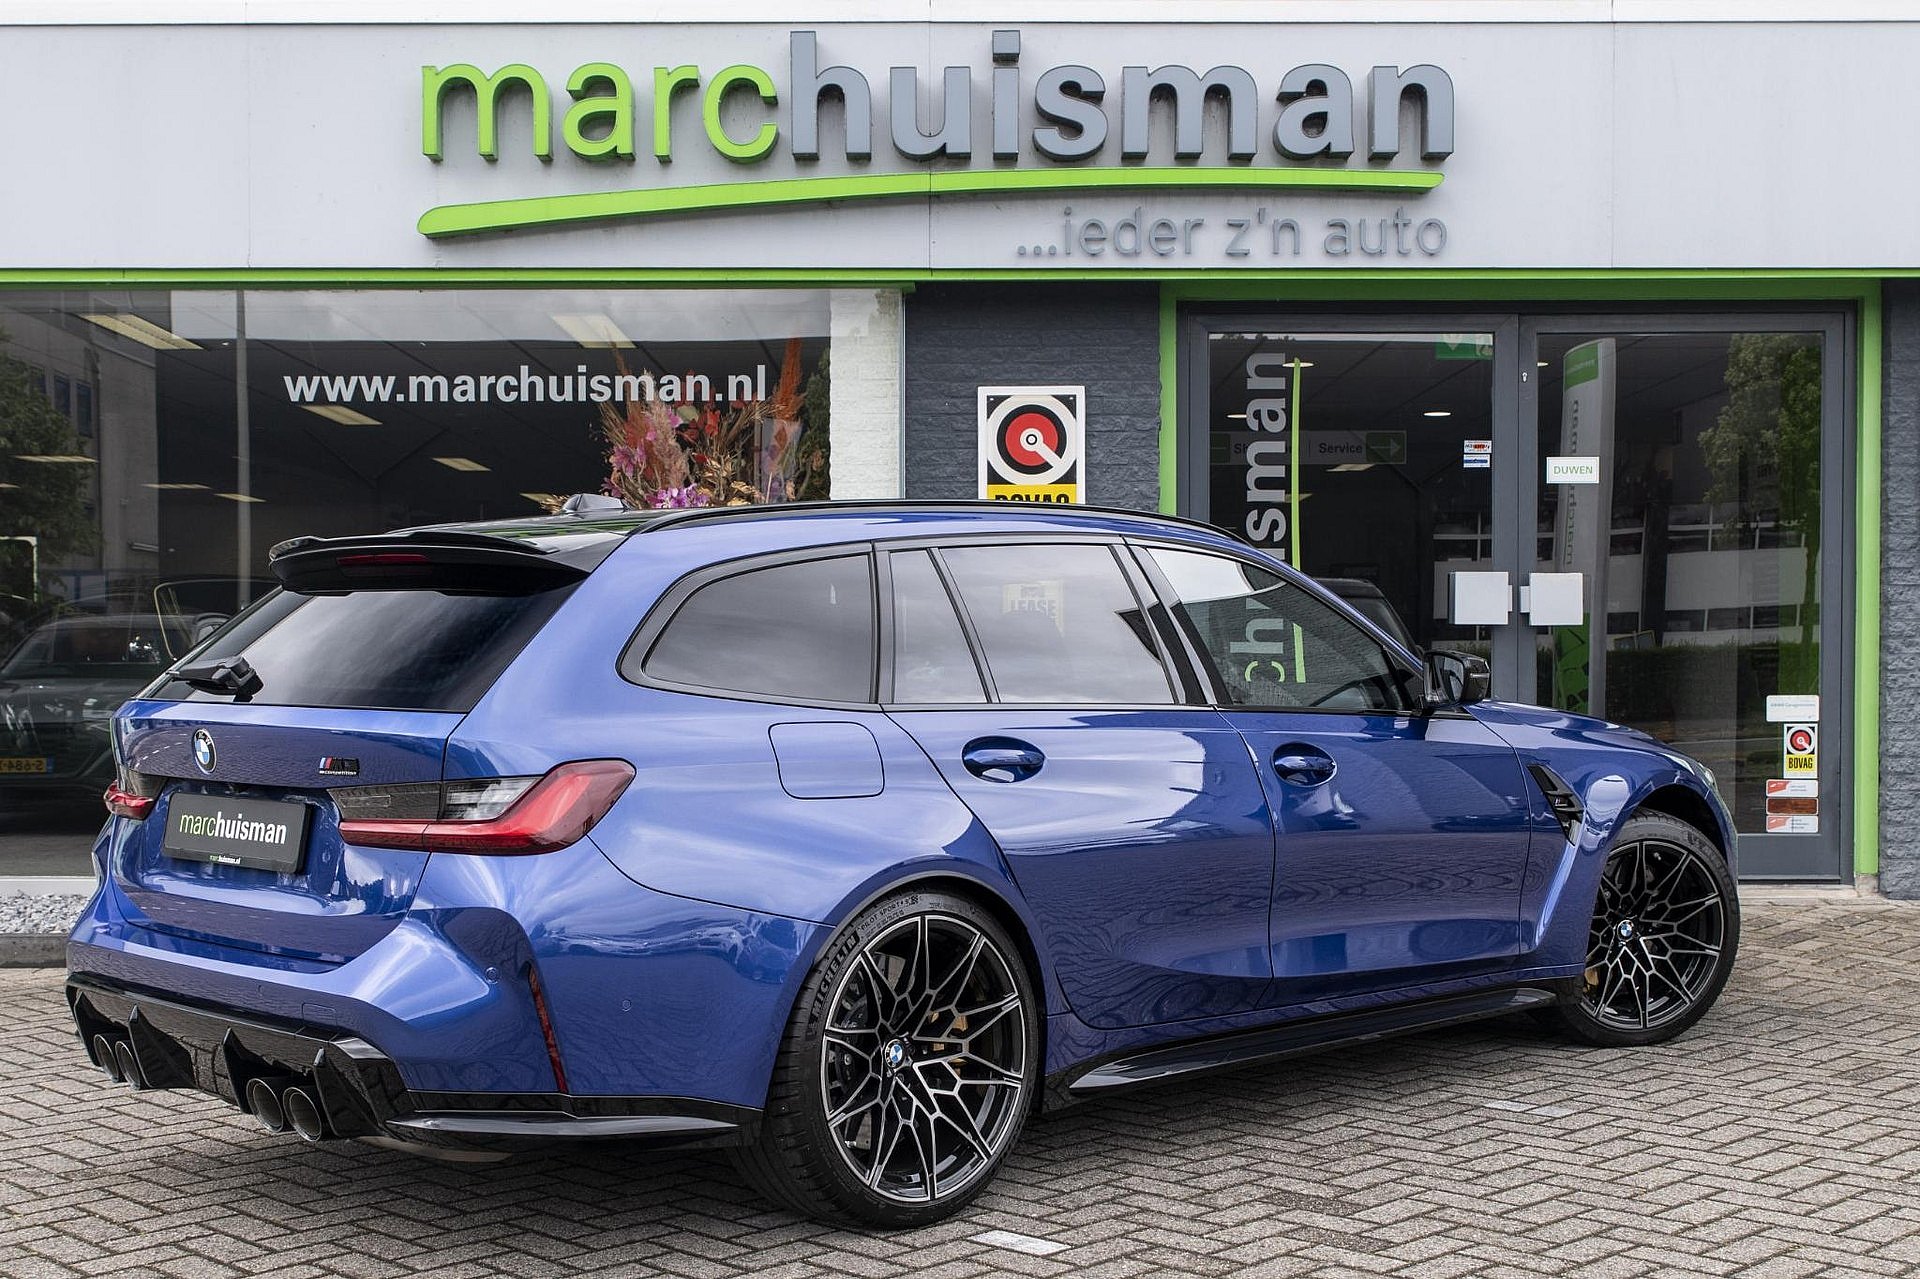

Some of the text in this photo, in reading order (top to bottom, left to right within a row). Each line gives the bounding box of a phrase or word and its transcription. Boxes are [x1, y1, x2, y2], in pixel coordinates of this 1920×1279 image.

[421, 30, 1455, 164] marchuisman
[1225, 207, 1301, 257] z'n
[1323, 208, 1448, 257] auto
[283, 365, 767, 402] www.marchuisman.nl
[1319, 442, 1362, 454] Service
[1553, 465, 1593, 475] DUWEN
[1788, 757, 1813, 769] BOVAG
[179, 811, 287, 844] marchuisman
[811, 930, 860, 1018] MICHELIN
